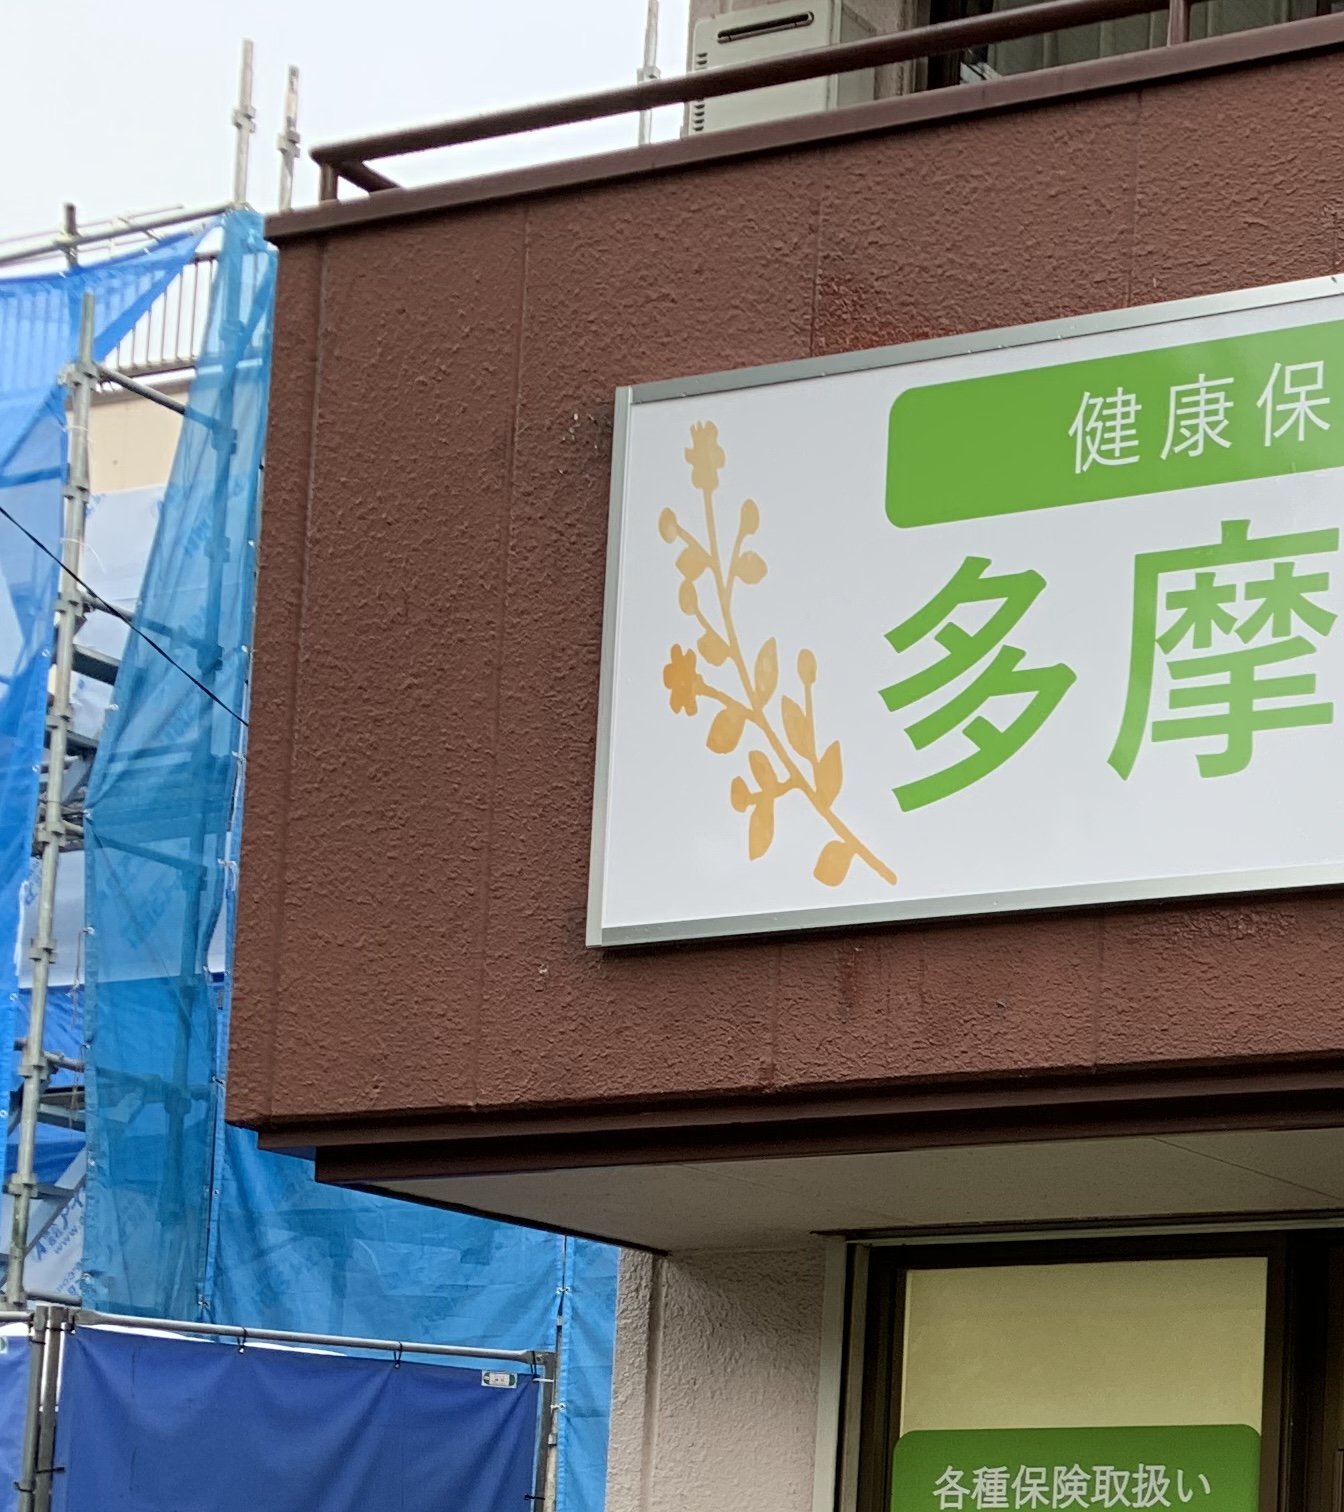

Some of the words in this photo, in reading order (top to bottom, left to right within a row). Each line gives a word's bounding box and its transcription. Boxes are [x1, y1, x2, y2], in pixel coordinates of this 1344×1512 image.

[932, 1463, 1212, 1511] 各種保険取扱い
